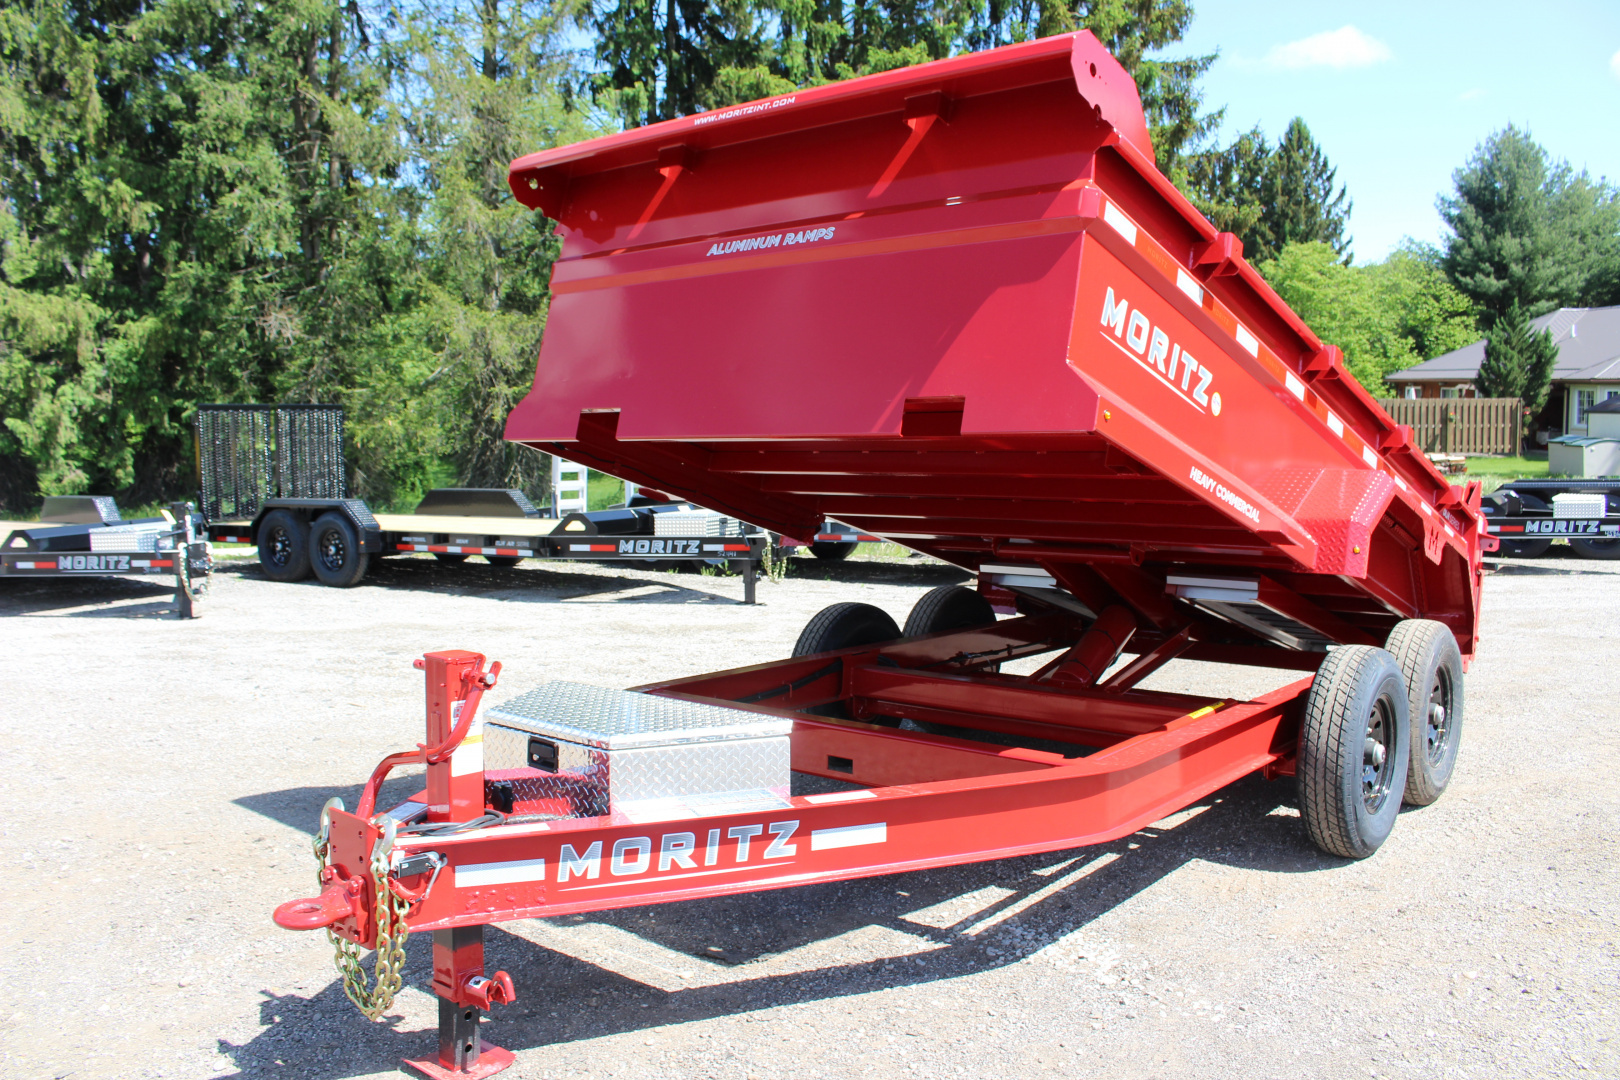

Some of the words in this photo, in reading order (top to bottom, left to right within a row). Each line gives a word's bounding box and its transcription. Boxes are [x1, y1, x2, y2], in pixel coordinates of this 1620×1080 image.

[694, 96, 796, 126] WWW.MORITZINT.COM
[706, 234, 783, 257] ALUMINUM
[783, 226, 836, 246] RAMPS
[1100, 285, 1213, 408] MORITZ
[1189, 466, 1217, 493] HEAVY
[1216, 484, 1260, 524] COMMERCIAL
[1525, 520, 1600, 533] MORITZ
[618, 539, 700, 554] MORITZ
[57, 555, 131, 570] MORITZ
[557, 819, 801, 883] MORITZ
